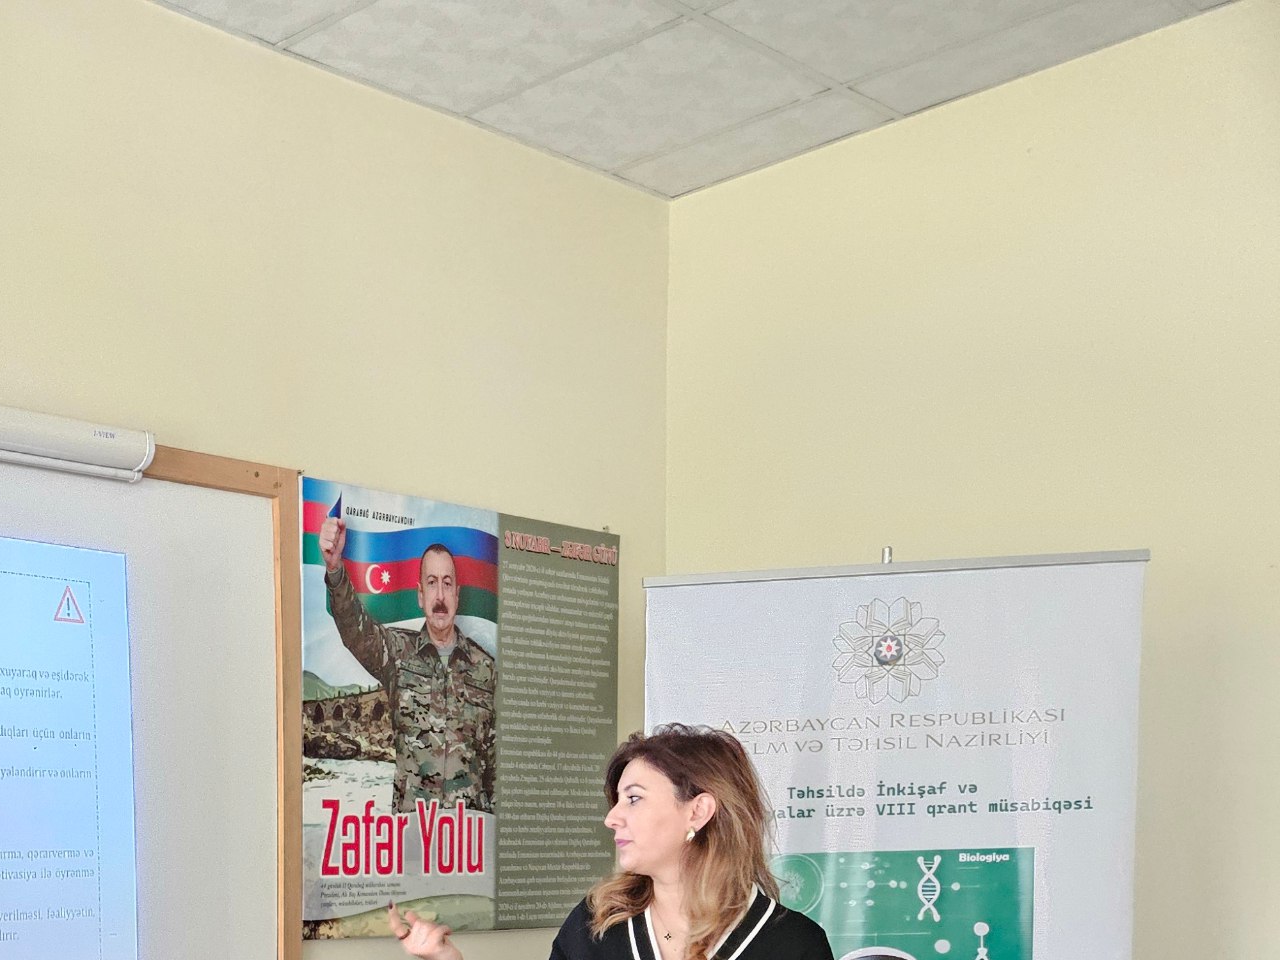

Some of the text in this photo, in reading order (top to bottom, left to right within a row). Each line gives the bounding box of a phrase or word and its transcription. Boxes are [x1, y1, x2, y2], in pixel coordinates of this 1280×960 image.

[721, 715, 881, 734] AZƏRBAYCAN
[795, 740, 823, 753] VƏ
[787, 781, 978, 799] Təhsildə İnkişaf və
[825, 805, 865, 817] üzrə
[876, 803, 915, 816] VIII
[927, 803, 978, 818] qrant
[989, 796, 1094, 814] müsabiqəsi
[321, 799, 409, 876] Zəfər
[417, 800, 484, 875] Yolu
[959, 852, 1010, 863] Biologiya
